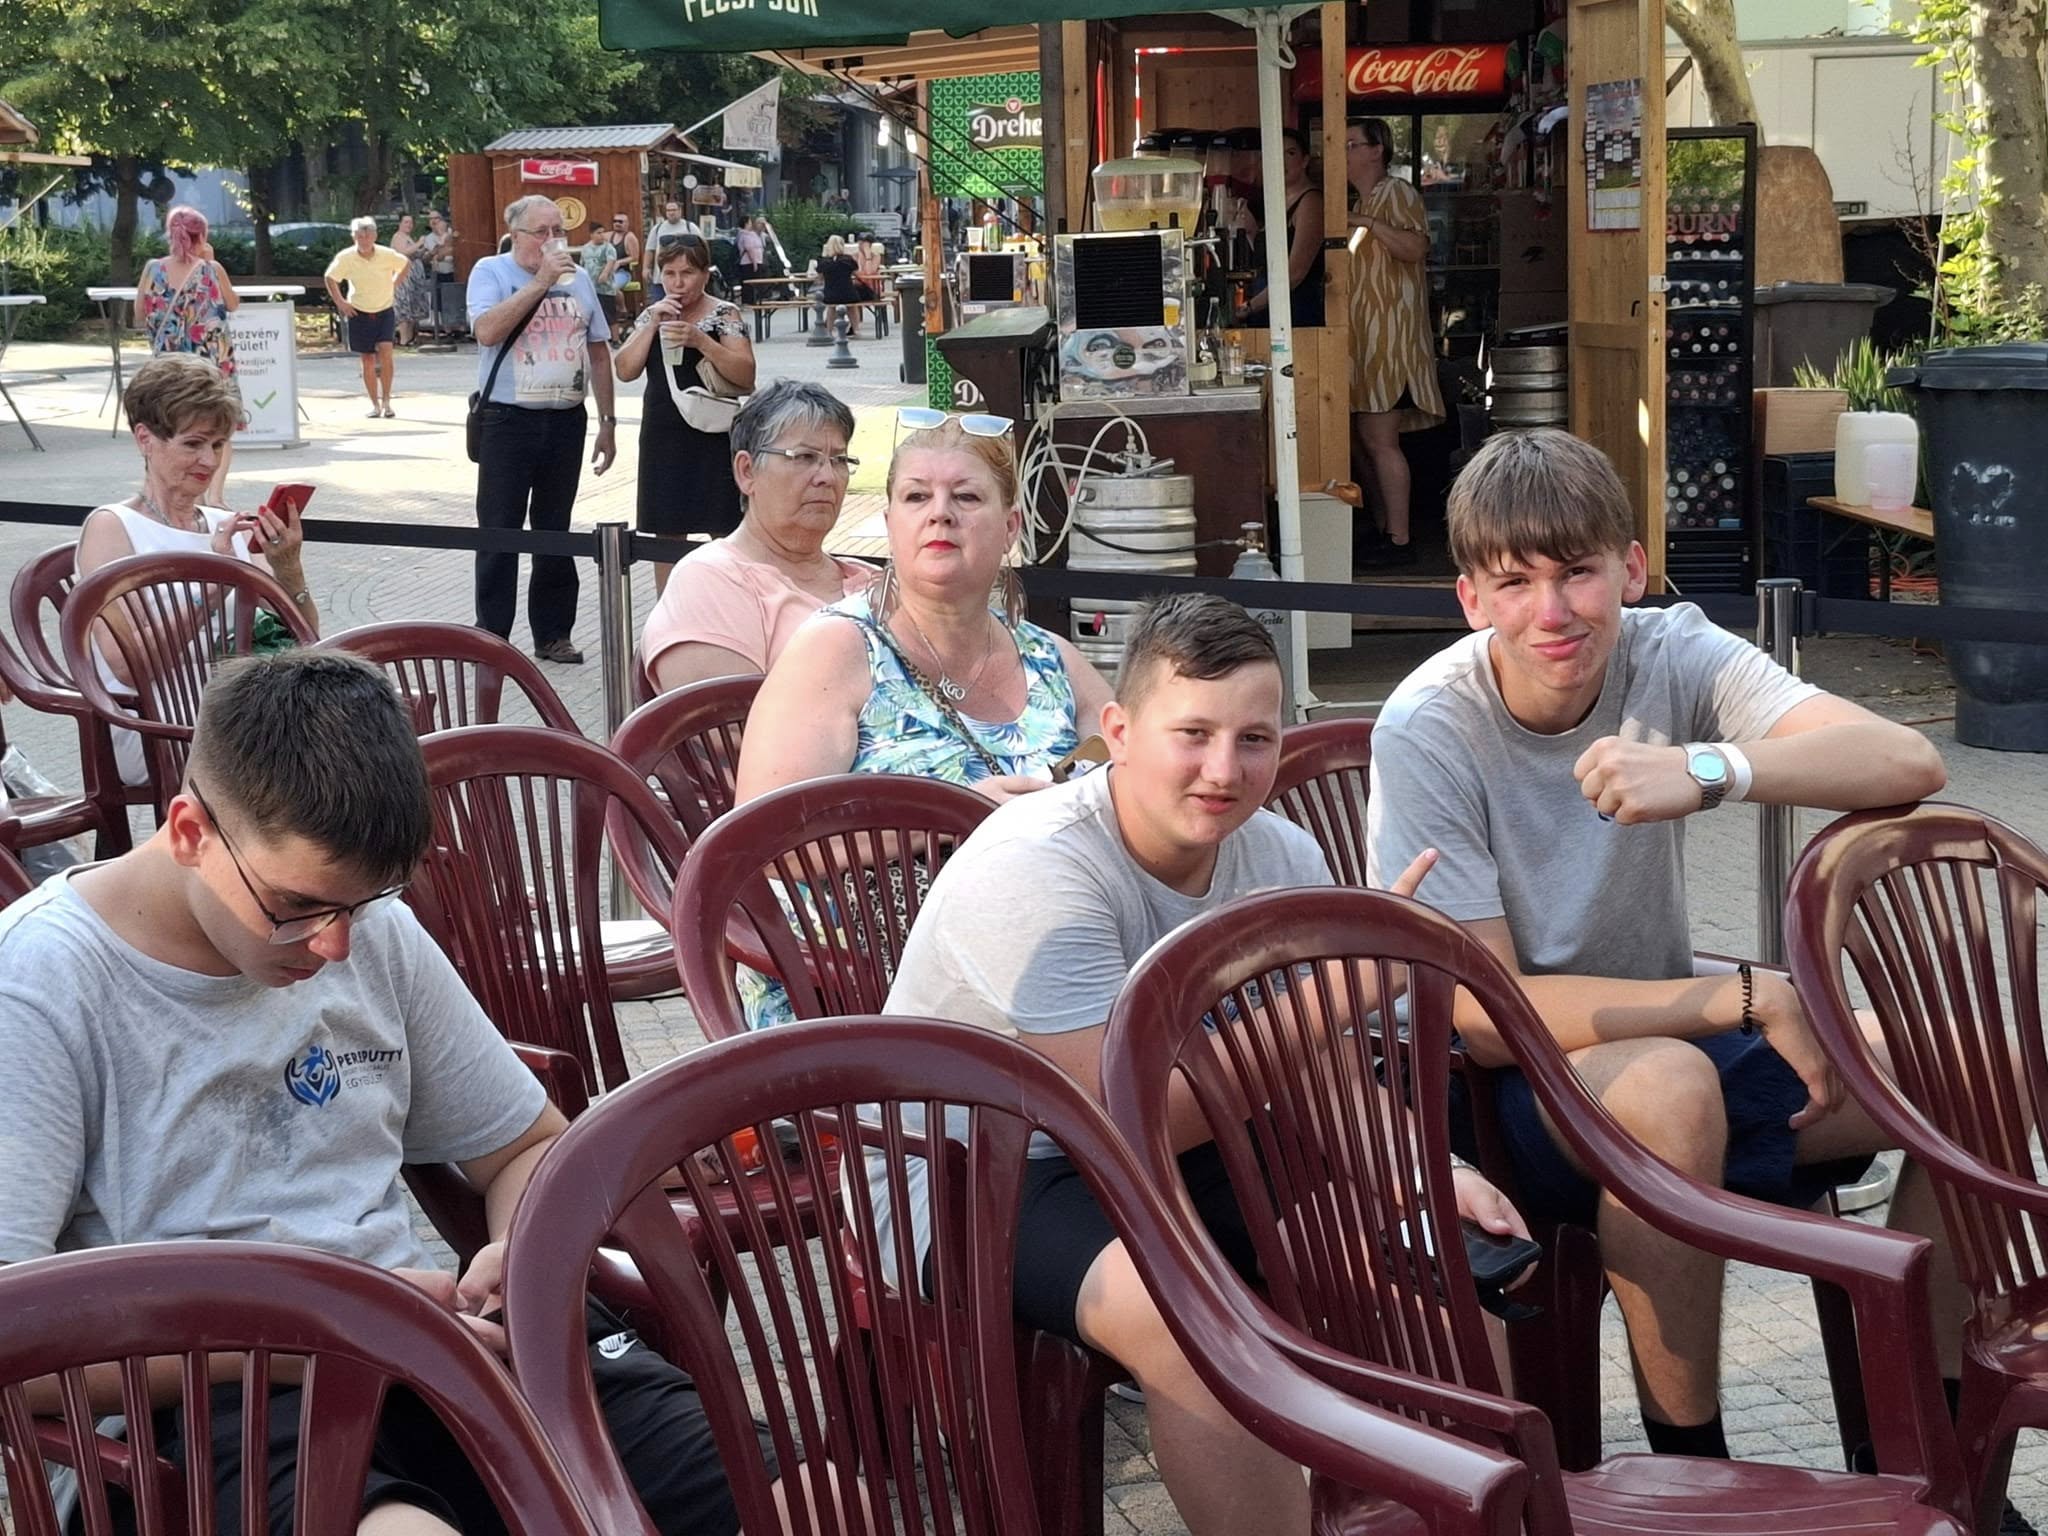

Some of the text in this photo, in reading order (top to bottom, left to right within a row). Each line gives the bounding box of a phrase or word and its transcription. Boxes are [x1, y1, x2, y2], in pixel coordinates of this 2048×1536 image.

[1348, 48, 1488, 95] Coca-Cola
[971, 111, 1043, 143] Drehe
[1665, 213, 1738, 234] BURN
[230, 327, 280, 341] dezvény
[233, 340, 269, 351] rület!
